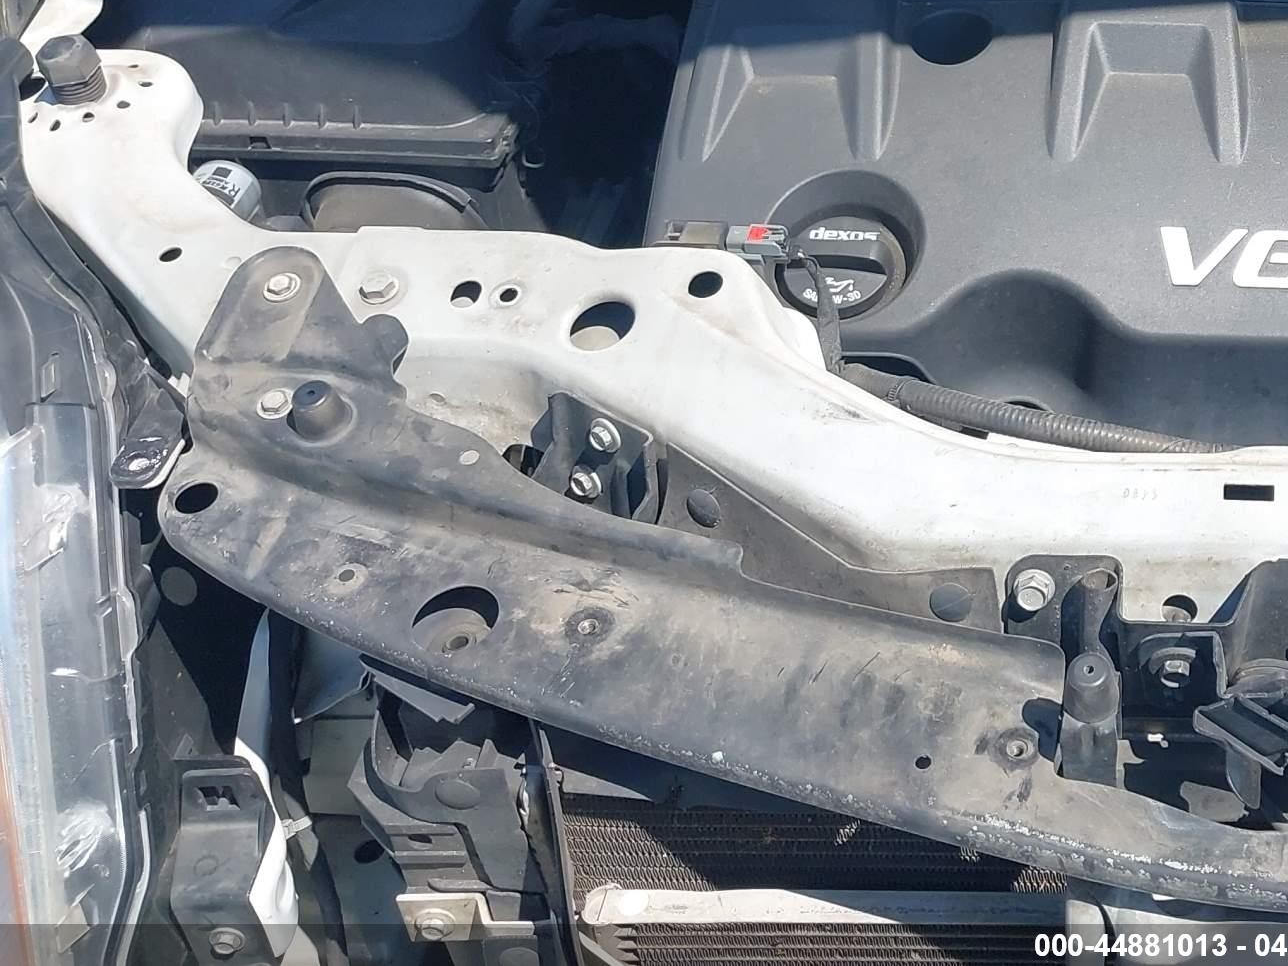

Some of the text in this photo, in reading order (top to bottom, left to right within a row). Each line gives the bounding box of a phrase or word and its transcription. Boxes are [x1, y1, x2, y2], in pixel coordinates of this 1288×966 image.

[809, 227, 880, 240] dexos
[803, 288, 861, 304] SA W-30
